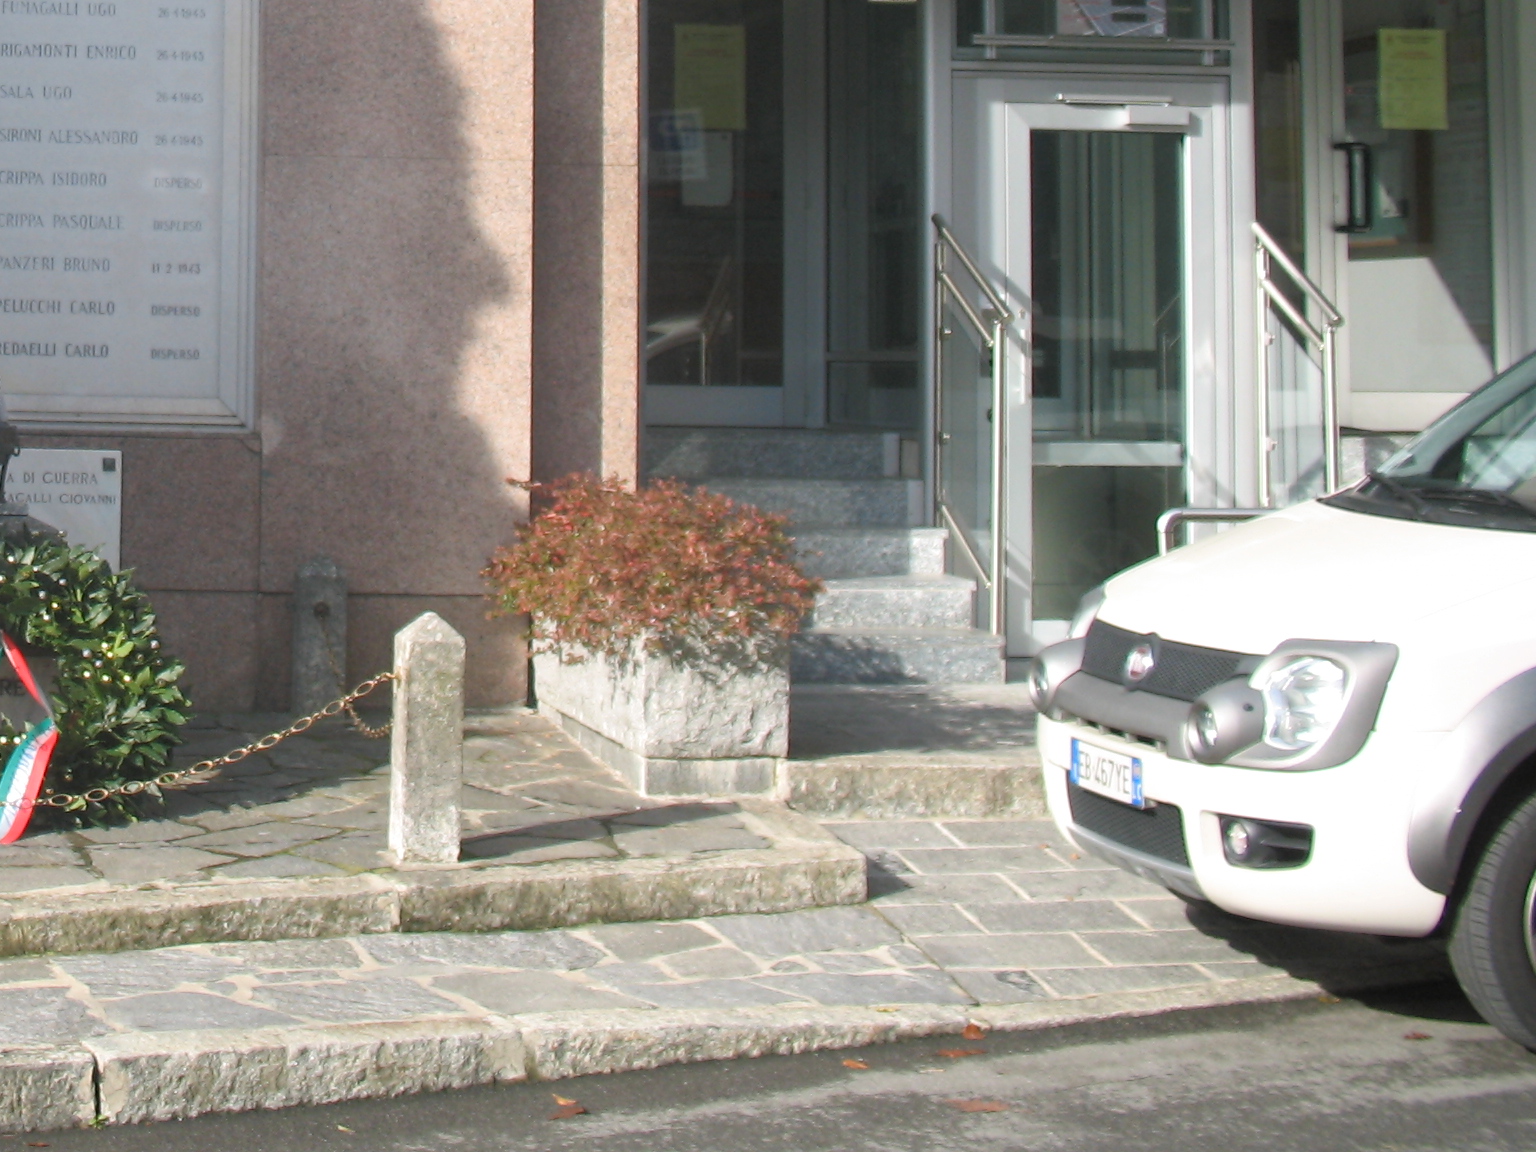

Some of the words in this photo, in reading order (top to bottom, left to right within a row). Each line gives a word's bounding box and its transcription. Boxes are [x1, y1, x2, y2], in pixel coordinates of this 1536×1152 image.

[2, 0, 78, 16] FUMAGALLI
[89, 2, 116, 17] UGO
[1, 43, 77, 59] RIGAMONTI
[87, 45, 136, 60] ENRICO
[0, 85, 34, 99] SALA
[43, 86, 72, 99] UGO
[0, 129, 41, 143] SIRONI
[48, 130, 138, 145] ALESSANDRO
[53, 172, 107, 187] ISIDORO
[155, 177, 202, 189] DISPERSO
[54, 214, 123, 230] PASQUALE
[153, 220, 202, 232] DISPERSO
[64, 257, 110, 272] BRUNO
[70, 300, 115, 315] CARLO
[152, 305, 200, 317] DISPERSO
[65, 343, 109, 358] CARLO
[151, 349, 200, 360] DISPERSO
[24, 472, 35, 483] DI
[43, 471, 98, 486] GUERRA
[59, 493, 116, 505] GIOVANNI
